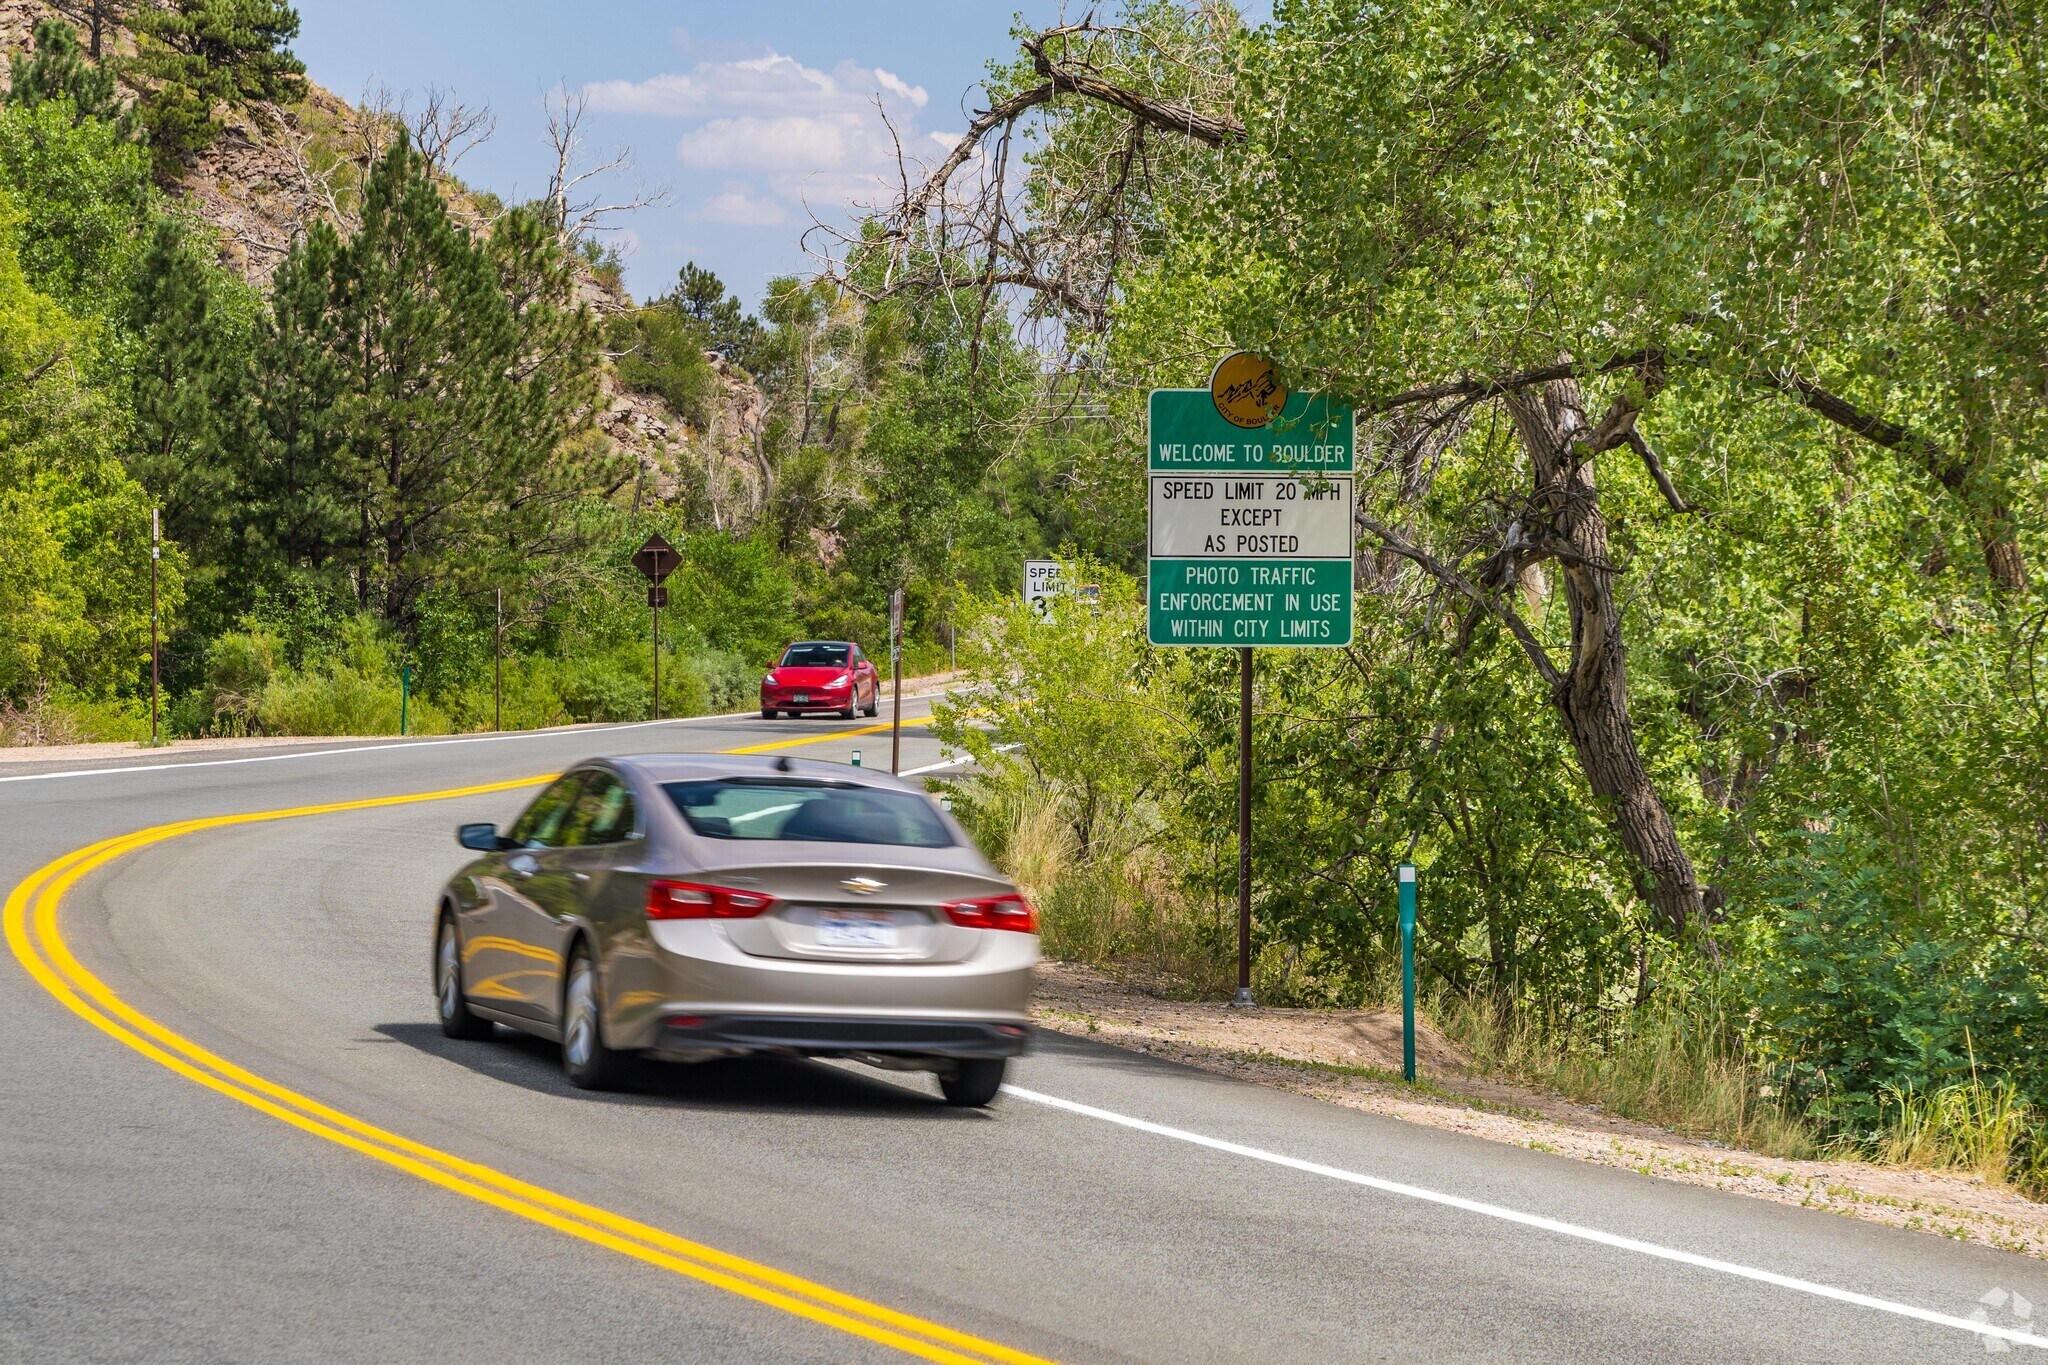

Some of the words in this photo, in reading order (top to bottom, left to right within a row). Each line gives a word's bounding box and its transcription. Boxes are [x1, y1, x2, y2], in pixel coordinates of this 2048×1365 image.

[1218, 402, 1234, 418] CITY
[1233, 415, 1245, 424] OF
[1159, 444, 1236, 463] WELCOME
[1243, 444, 1263, 462] TO
[1271, 444, 1345, 463] BOULDER
[1162, 481, 1214, 500] SPEED
[1225, 482, 1264, 500] LIMIT
[1275, 482, 1297, 500] 20
[1220, 508, 1282, 527] EXCEPT
[1204, 534, 1226, 552] AS
[1237, 535, 1299, 553] POSTED
[1186, 567, 1239, 585] PHOTO
[1250, 567, 1316, 586] TRAFFIC
[1033, 581, 1067, 592] LIMIT
[1160, 592, 1274, 611] ENFORCEMENT
[1285, 594, 1300, 611] IN
[1310, 594, 1341, 612] USE
[1171, 619, 1223, 638] WITHIN
[1233, 620, 1269, 638] CITY
[1280, 620, 1330, 638] LIMITS
